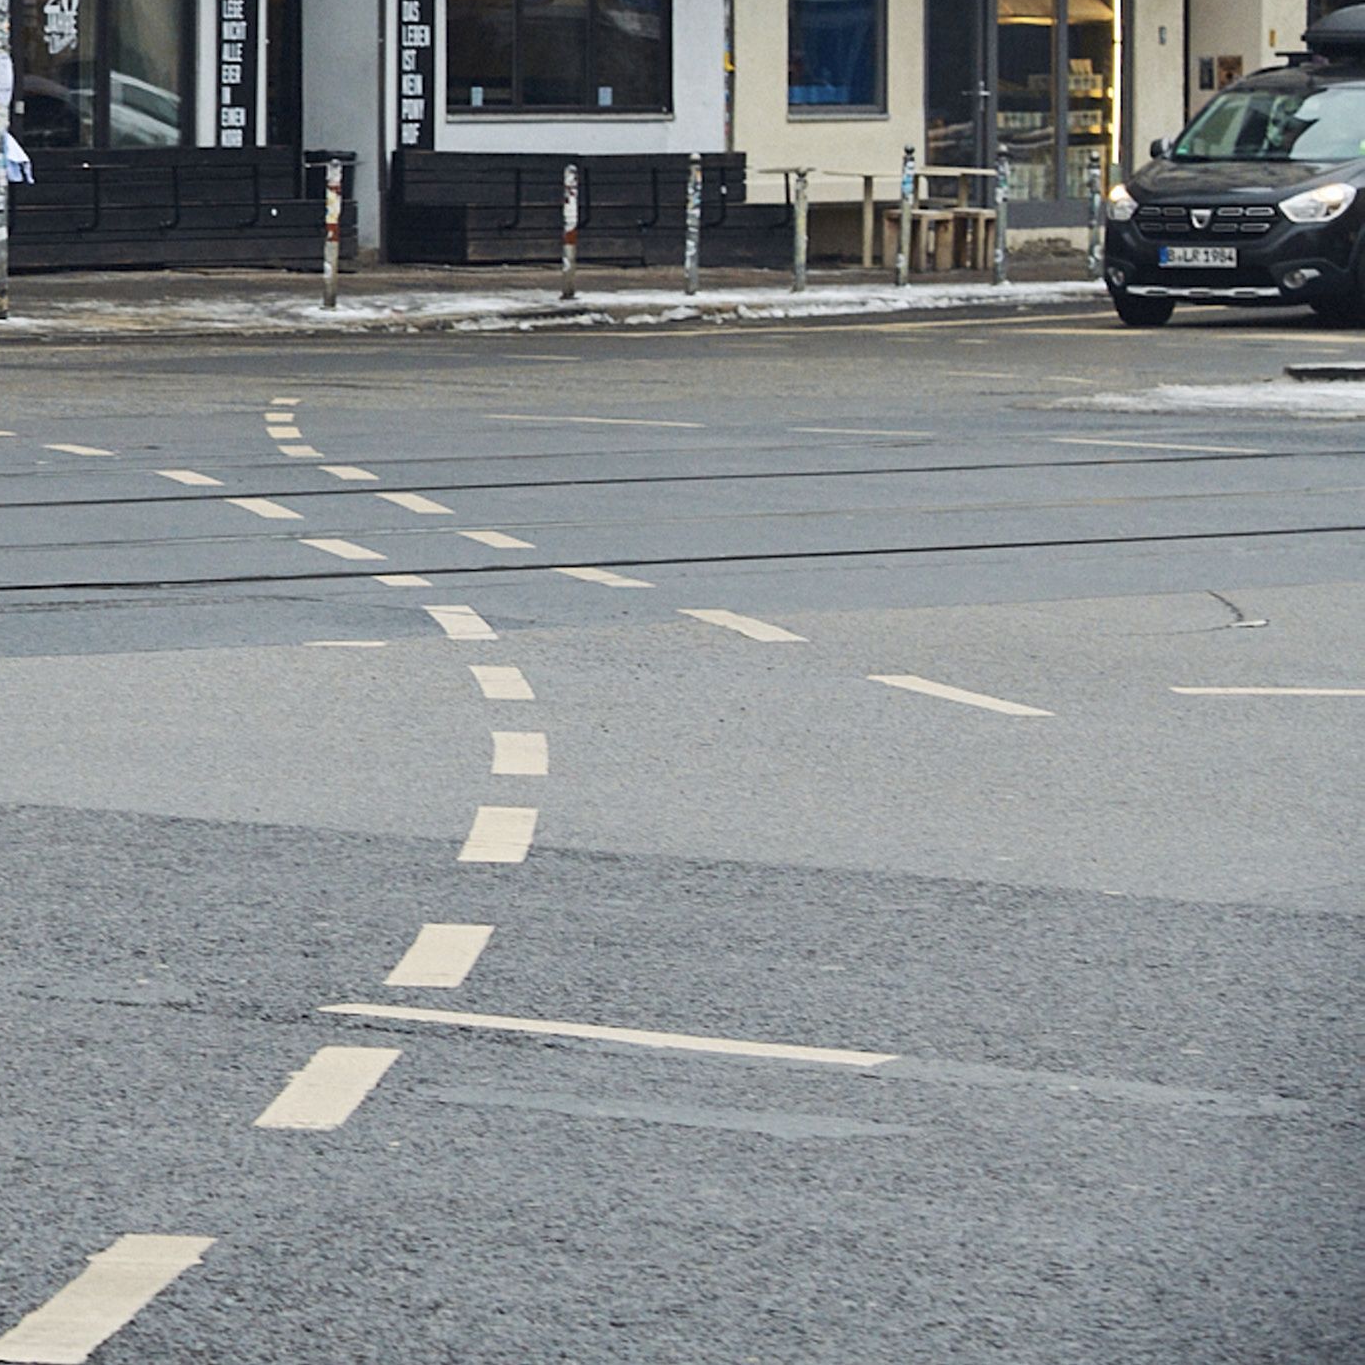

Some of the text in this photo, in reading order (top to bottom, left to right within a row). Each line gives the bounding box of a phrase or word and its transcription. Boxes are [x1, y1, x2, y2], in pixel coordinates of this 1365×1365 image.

[401, 0, 420, 22] DAS
[401, 24, 431, 47] LEBEN
[401, 48, 418, 71] IST
